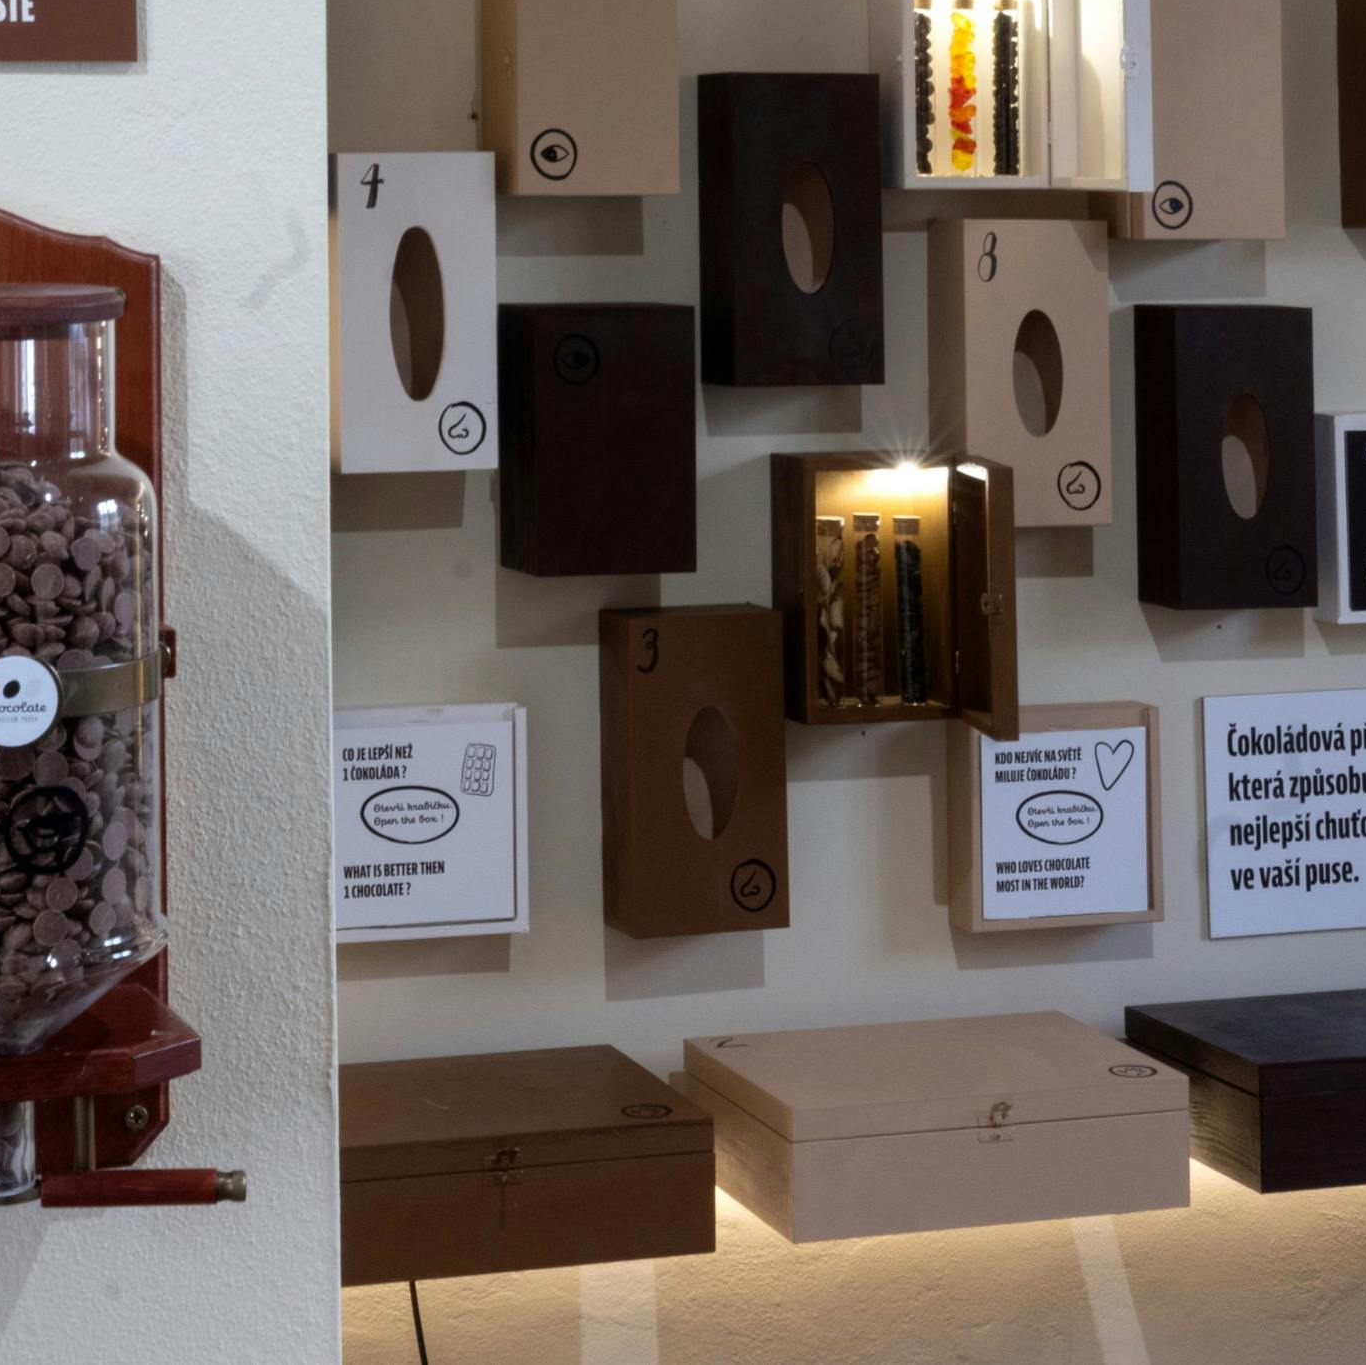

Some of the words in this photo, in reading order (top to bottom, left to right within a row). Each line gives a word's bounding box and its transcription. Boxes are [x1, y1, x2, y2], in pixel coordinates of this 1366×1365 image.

[360, 163, 385, 210] 4
[977, 231, 998, 283] 8
[636, 627, 660, 674] 3
[1227, 719, 1345, 757] Čokoládová
[342, 748, 354, 761] CO
[356, 748, 366, 761] JE
[368, 744, 394, 760] LEPŠÍ
[395, 743, 413, 759] NEŽ
[995, 752, 1012, 764] KDO
[1014, 748, 1043, 763] NEJVÍC
[1044, 750, 1057, 761] NA
[343, 768, 349, 781] 1
[350, 766, 400, 780] ČOKOLÁDA
[402, 765, 407, 778] ?
[995, 770, 1025, 783] MILUJE
[1027, 767, 1070, 782] ČOKOLÁDU
[1071, 767, 1077, 779] ?
[1228, 771, 1285, 801] která
[374, 817, 399, 827] Open
[401, 816, 416, 825] the
[419, 815, 438, 823] box
[1028, 819, 1050, 830] Open
[1052, 819, 1064, 827] the
[1229, 813, 1311, 851] nejlepší
[344, 865, 371, 879] WHAT
[373, 865, 382, 878] IS
[385, 862, 418, 877] BETTER
[420, 861, 445, 875] THEN
[996, 861, 1017, 875] WHO
[1018, 859, 1043, 873] LOVES
[1044, 857, 1090, 872] CHOCOLATE
[1231, 867, 1255, 891] ve
[1259, 858, 1301, 889] vaší
[1305, 860, 1360, 892] puse.
[344, 886, 350, 899] 1
[352, 883, 404, 898] CHOCOLATE
[406, 882, 411, 895] ?
[996, 879, 1020, 893] MOST
[1021, 879, 1031, 891] IN
[1033, 878, 1048, 890] THE
[1050, 876, 1085, 889] WORLD?
